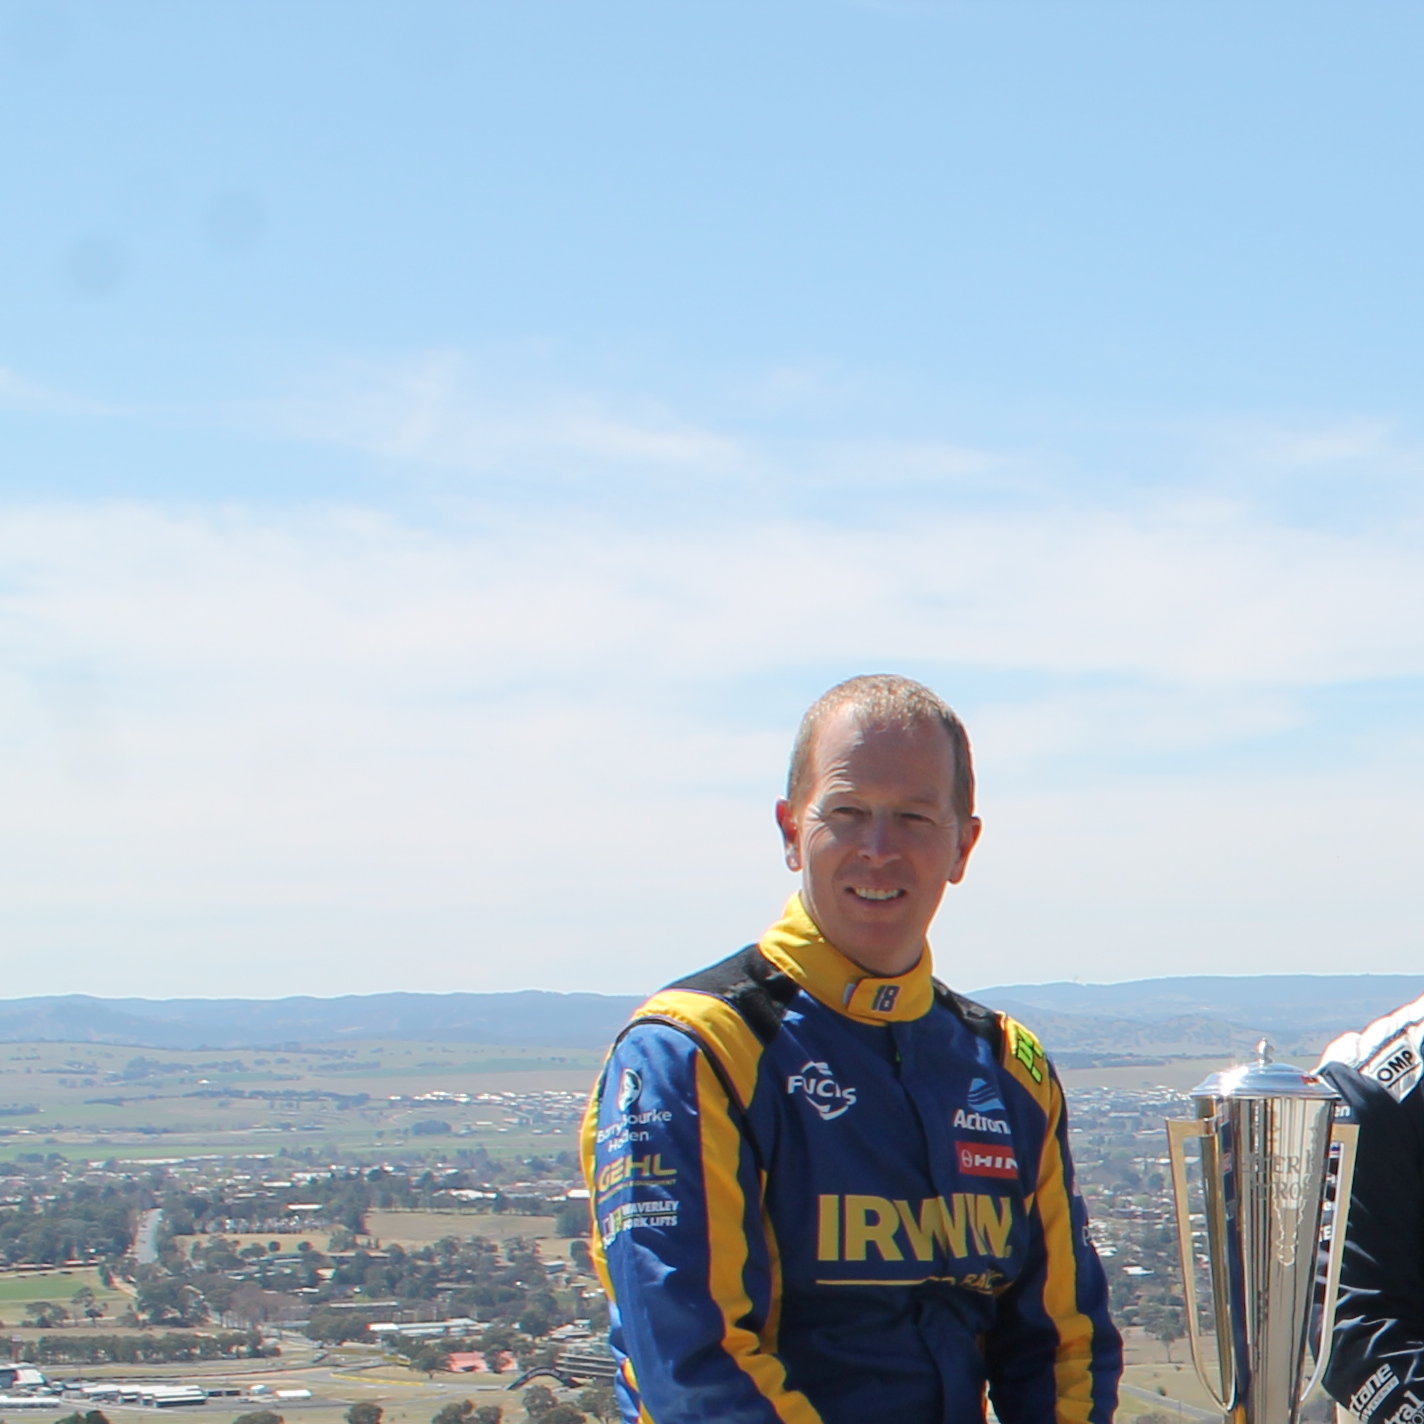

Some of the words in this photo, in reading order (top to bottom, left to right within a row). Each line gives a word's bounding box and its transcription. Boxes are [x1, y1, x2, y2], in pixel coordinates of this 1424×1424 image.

[870, 984, 901, 1013] 18
[1376, 1050, 1414, 1083] OMP
[953, 1109, 1012, 1134] Actron
[607, 1129, 651, 1153] Hoden
[596, 1153, 678, 1193] GEHL
[621, 1200, 680, 1213] WAVERLEY
